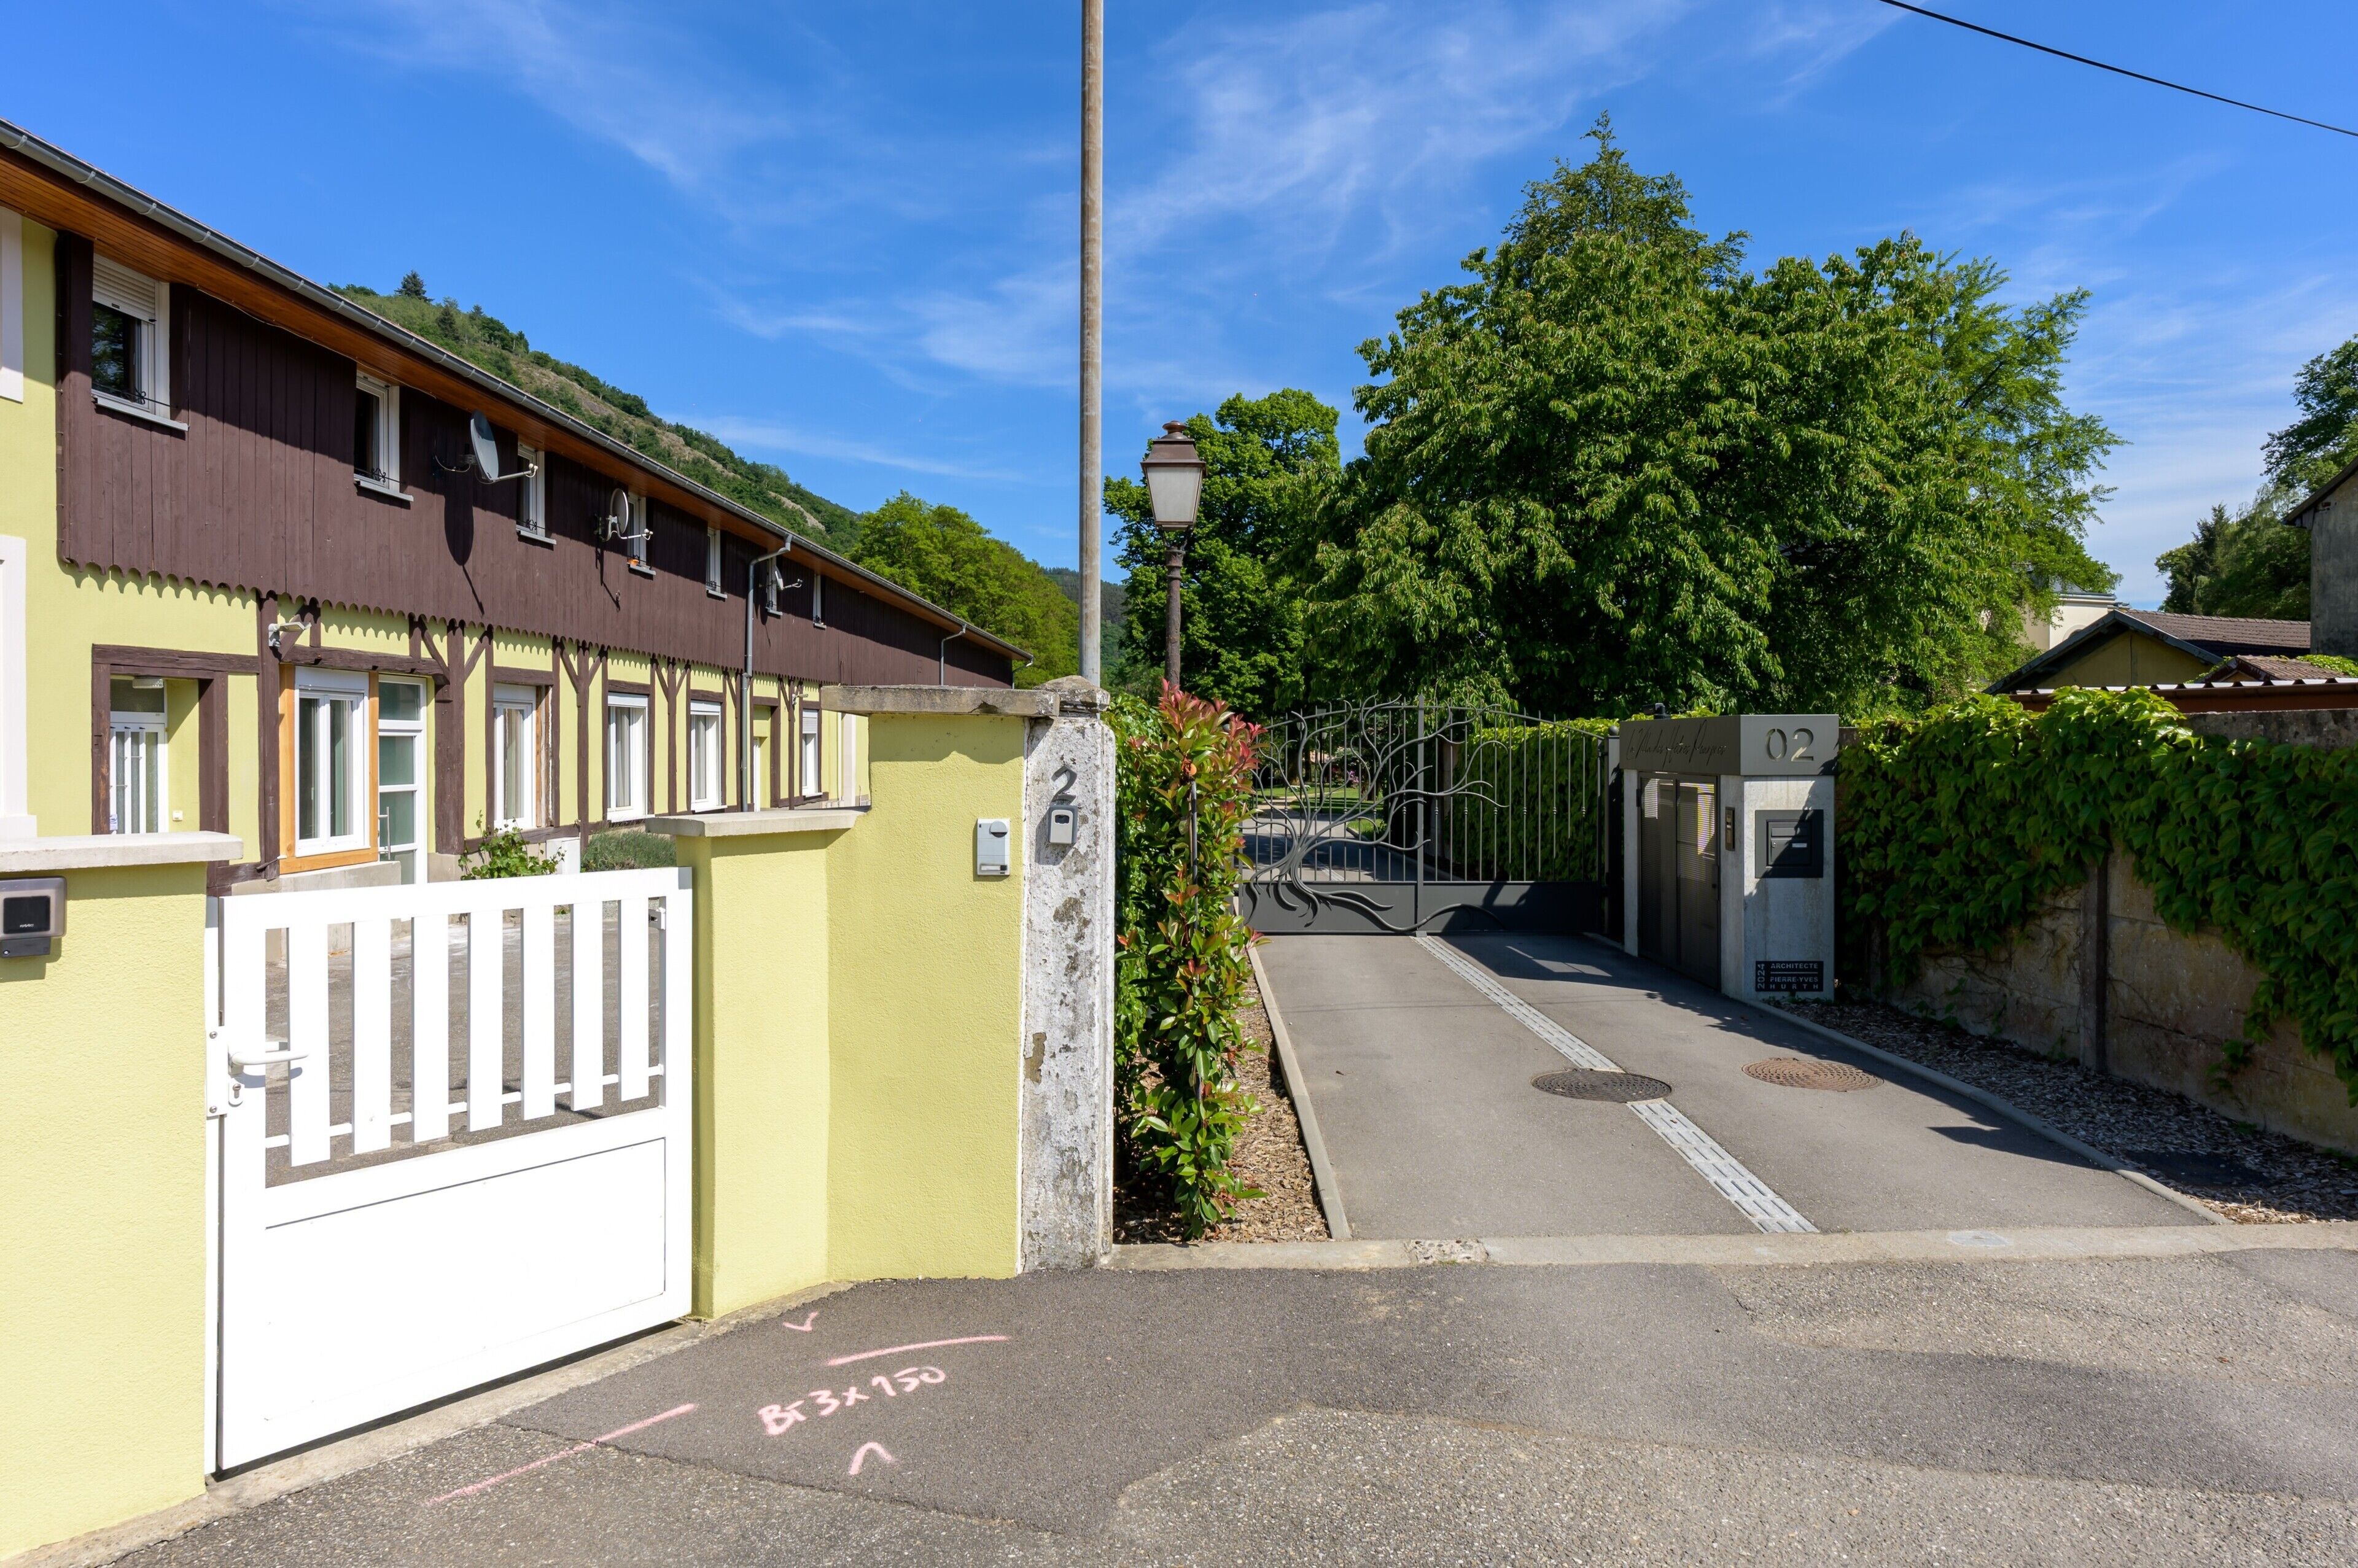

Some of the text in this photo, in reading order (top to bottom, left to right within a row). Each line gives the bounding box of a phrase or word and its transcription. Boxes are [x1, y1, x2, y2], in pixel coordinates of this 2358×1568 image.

[1766, 728, 1814, 761] 02
[1051, 766, 1077, 804] 2
[1757, 963, 1765, 989] 2024
